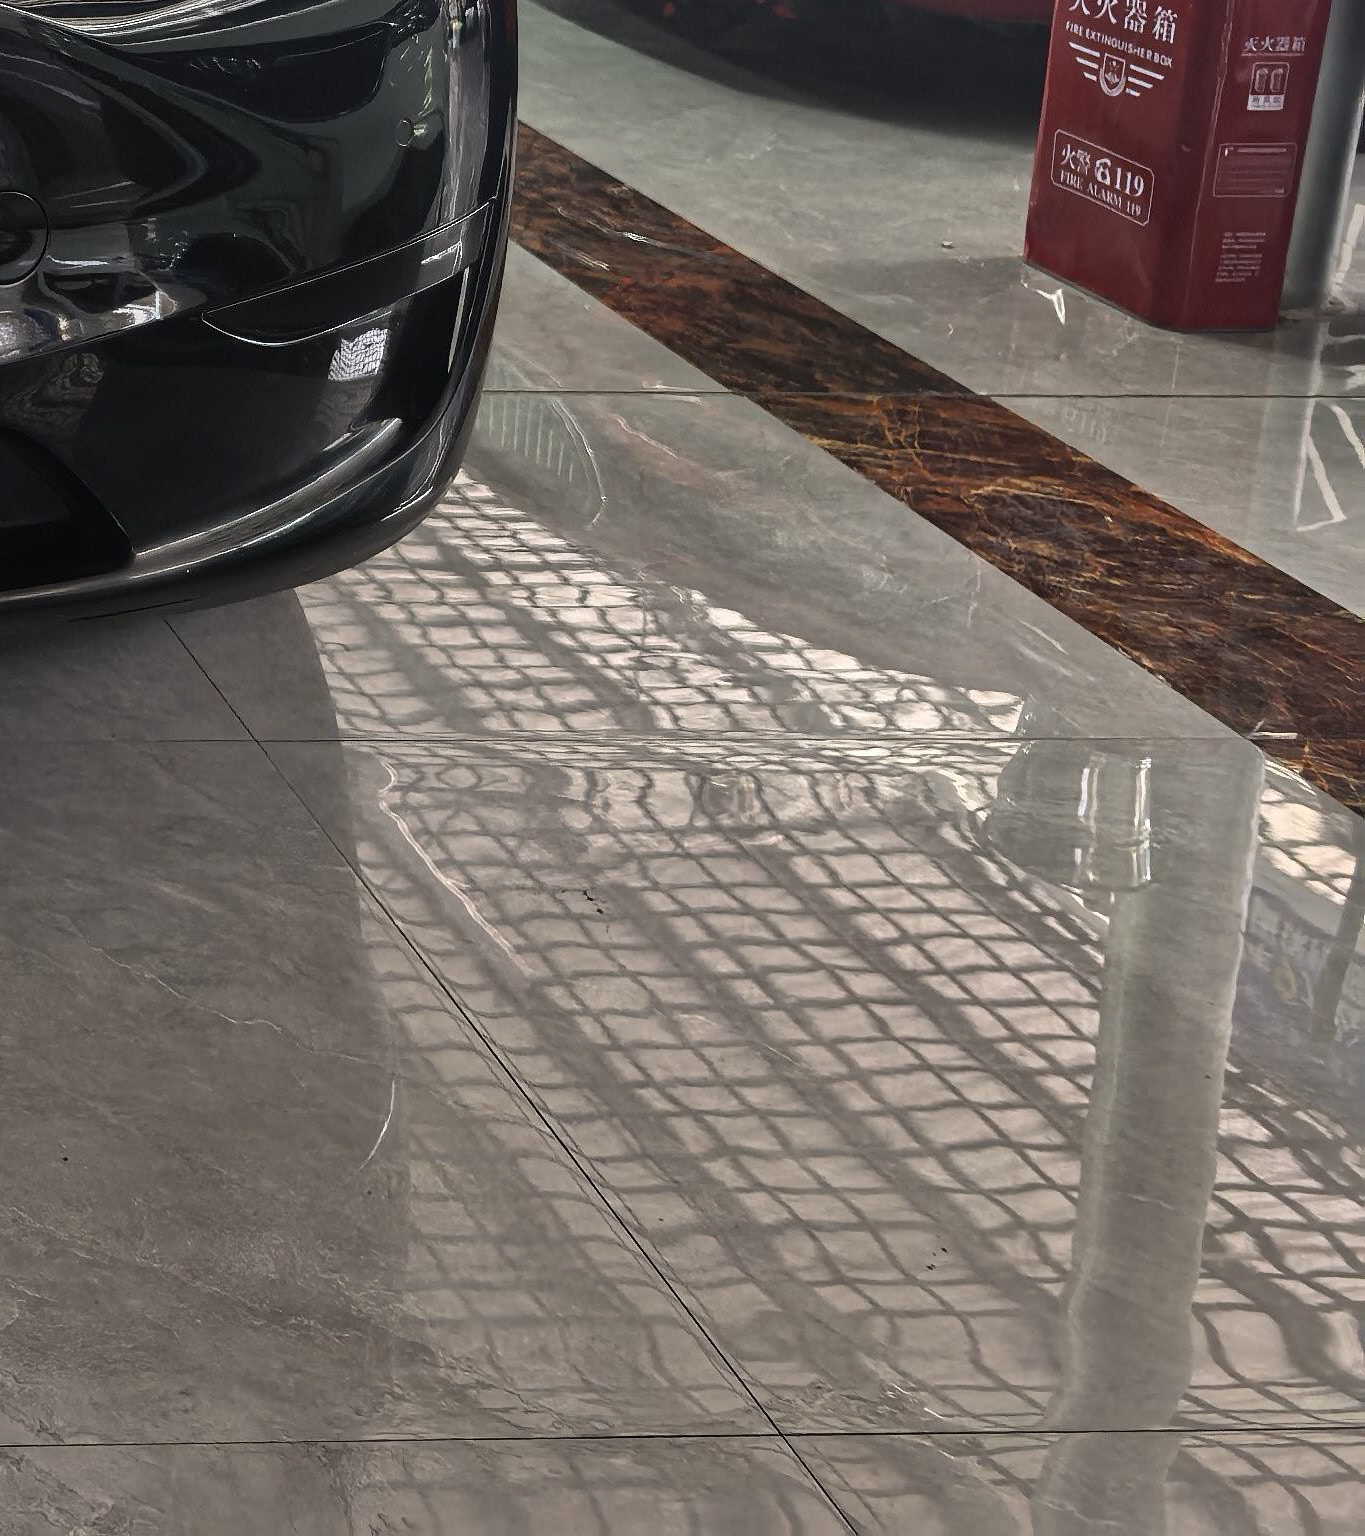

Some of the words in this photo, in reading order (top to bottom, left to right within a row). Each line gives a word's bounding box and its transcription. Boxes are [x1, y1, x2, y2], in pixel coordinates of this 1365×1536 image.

[1065, 20, 1084, 37] FIRE
[1154, 52, 1174, 68] BOX
[1242, 36, 1307, 52] 灭火器箱
[1060, 144, 1091, 175] 火警
[1115, 167, 1145, 198] 119
[1060, 169, 1083, 191] FIRE
